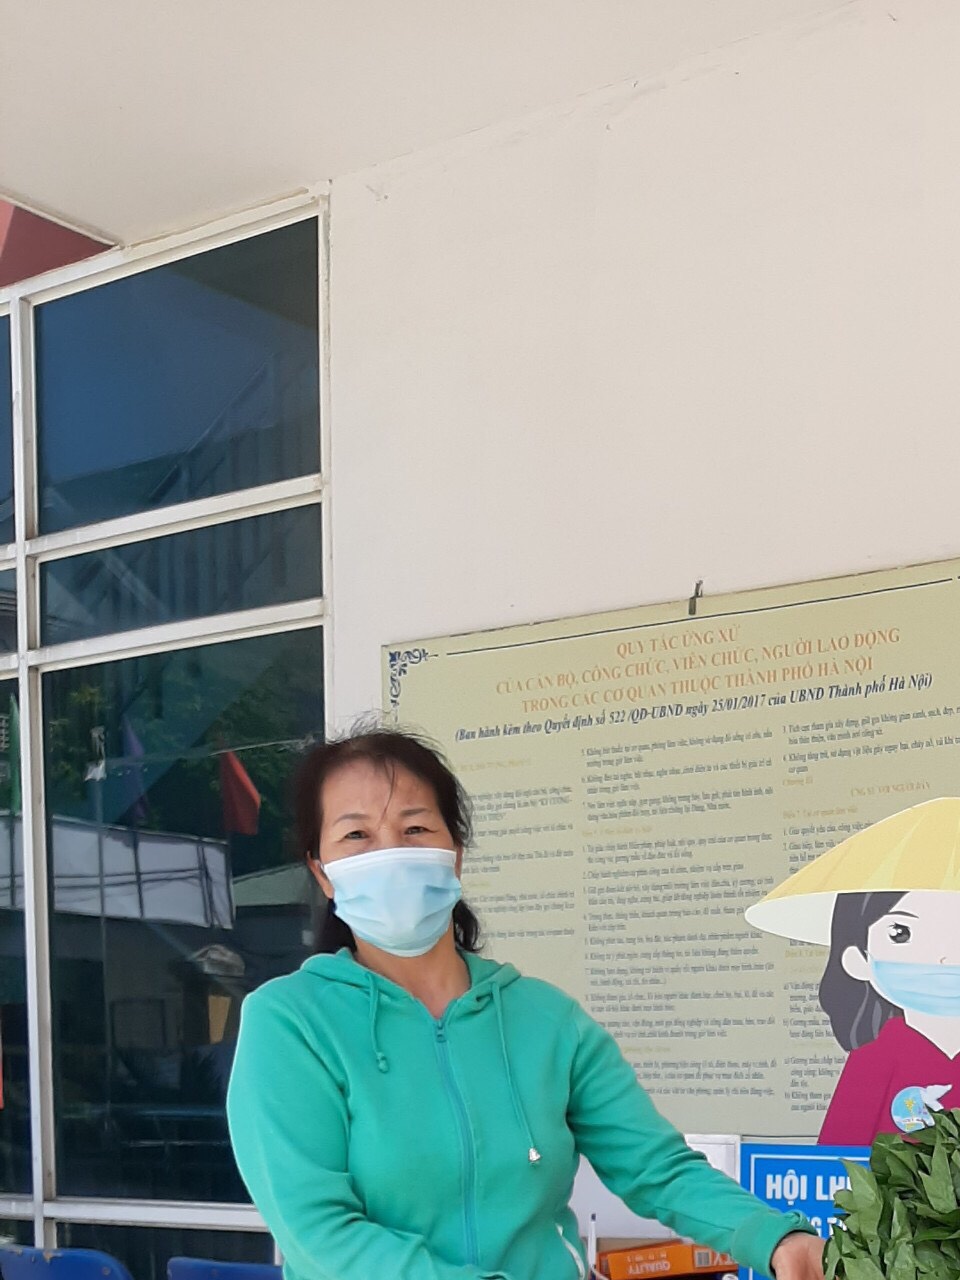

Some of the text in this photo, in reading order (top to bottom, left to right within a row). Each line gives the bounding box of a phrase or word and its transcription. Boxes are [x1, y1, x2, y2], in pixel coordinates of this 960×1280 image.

[617, 641, 643, 659] QUY
[853, 628, 900, 650] ĐỘNG
[521, 693, 569, 713] TRONG
[671, 674, 720, 694] THUỘC
[725, 668, 777, 689] THÀNH
[844, 655, 872, 676] NỘI
[455, 728, 476, 744] (Ban
[478, 725, 500, 739] hành
[523, 721, 541, 734] theo
[545, 713, 571, 734] Quyết
[573, 714, 593, 730] định
[595, 709, 606, 726] số
[609, 709, 626, 724] 522
[686, 701, 708, 718] ngày
[711, 694, 766, 713] 25/01/2017
[768, 691, 787, 706] của
[789, 687, 825, 703] UBND
[829, 681, 862, 699] Thành
[864, 674, 887, 698] phố
[888, 675, 905, 691] Hà
[909, 672, 932, 691] Nội)
[766, 1169, 807, 1206] HỘI
[627, 1261, 671, 1275] QUALITY
